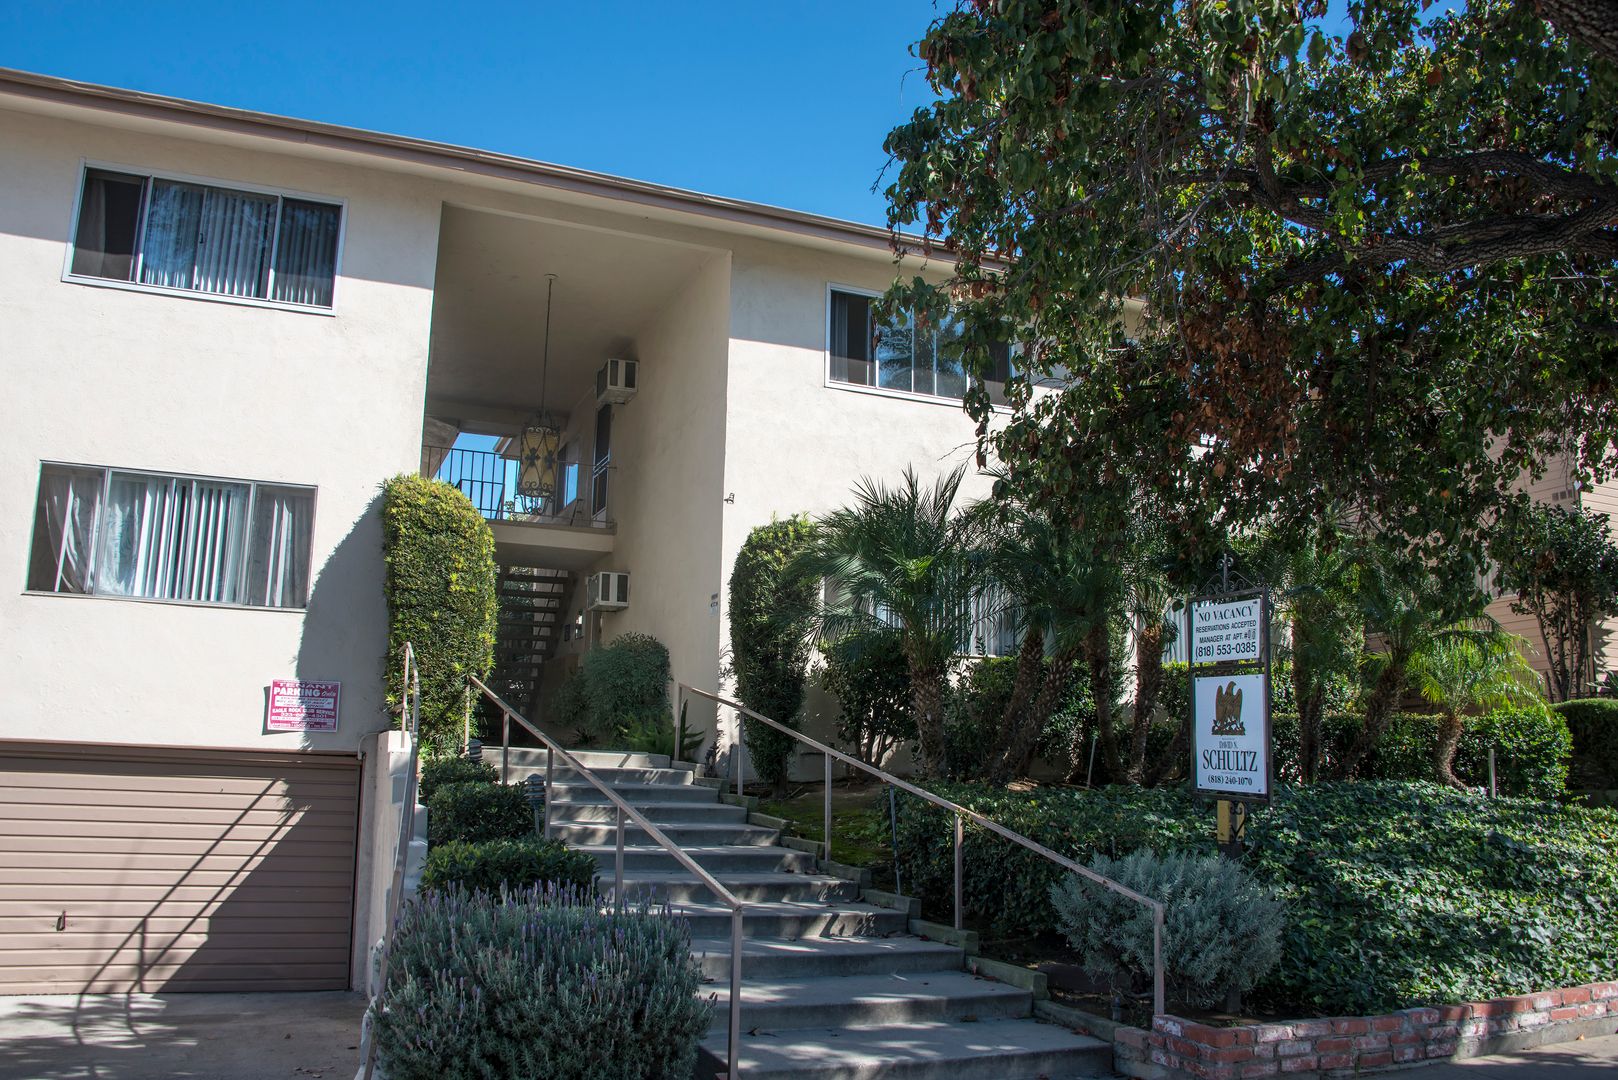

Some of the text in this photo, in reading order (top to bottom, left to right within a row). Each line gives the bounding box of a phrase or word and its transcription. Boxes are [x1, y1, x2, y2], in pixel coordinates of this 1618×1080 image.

[1199, 605, 1253, 622] NO VACANCY
[1196, 620, 1256, 633] RESERVATIONS ACCEPTED
[1199, 635, 1223, 644] MANAGER
[1225, 633, 1232, 641] AT
[1196, 642, 1256, 658] (818) 553-0385
[273, 687, 320, 697] PARKING
[1203, 749, 1258, 772] SCHULTZ
[1208, 775, 1252, 785] (818) 240-1070
